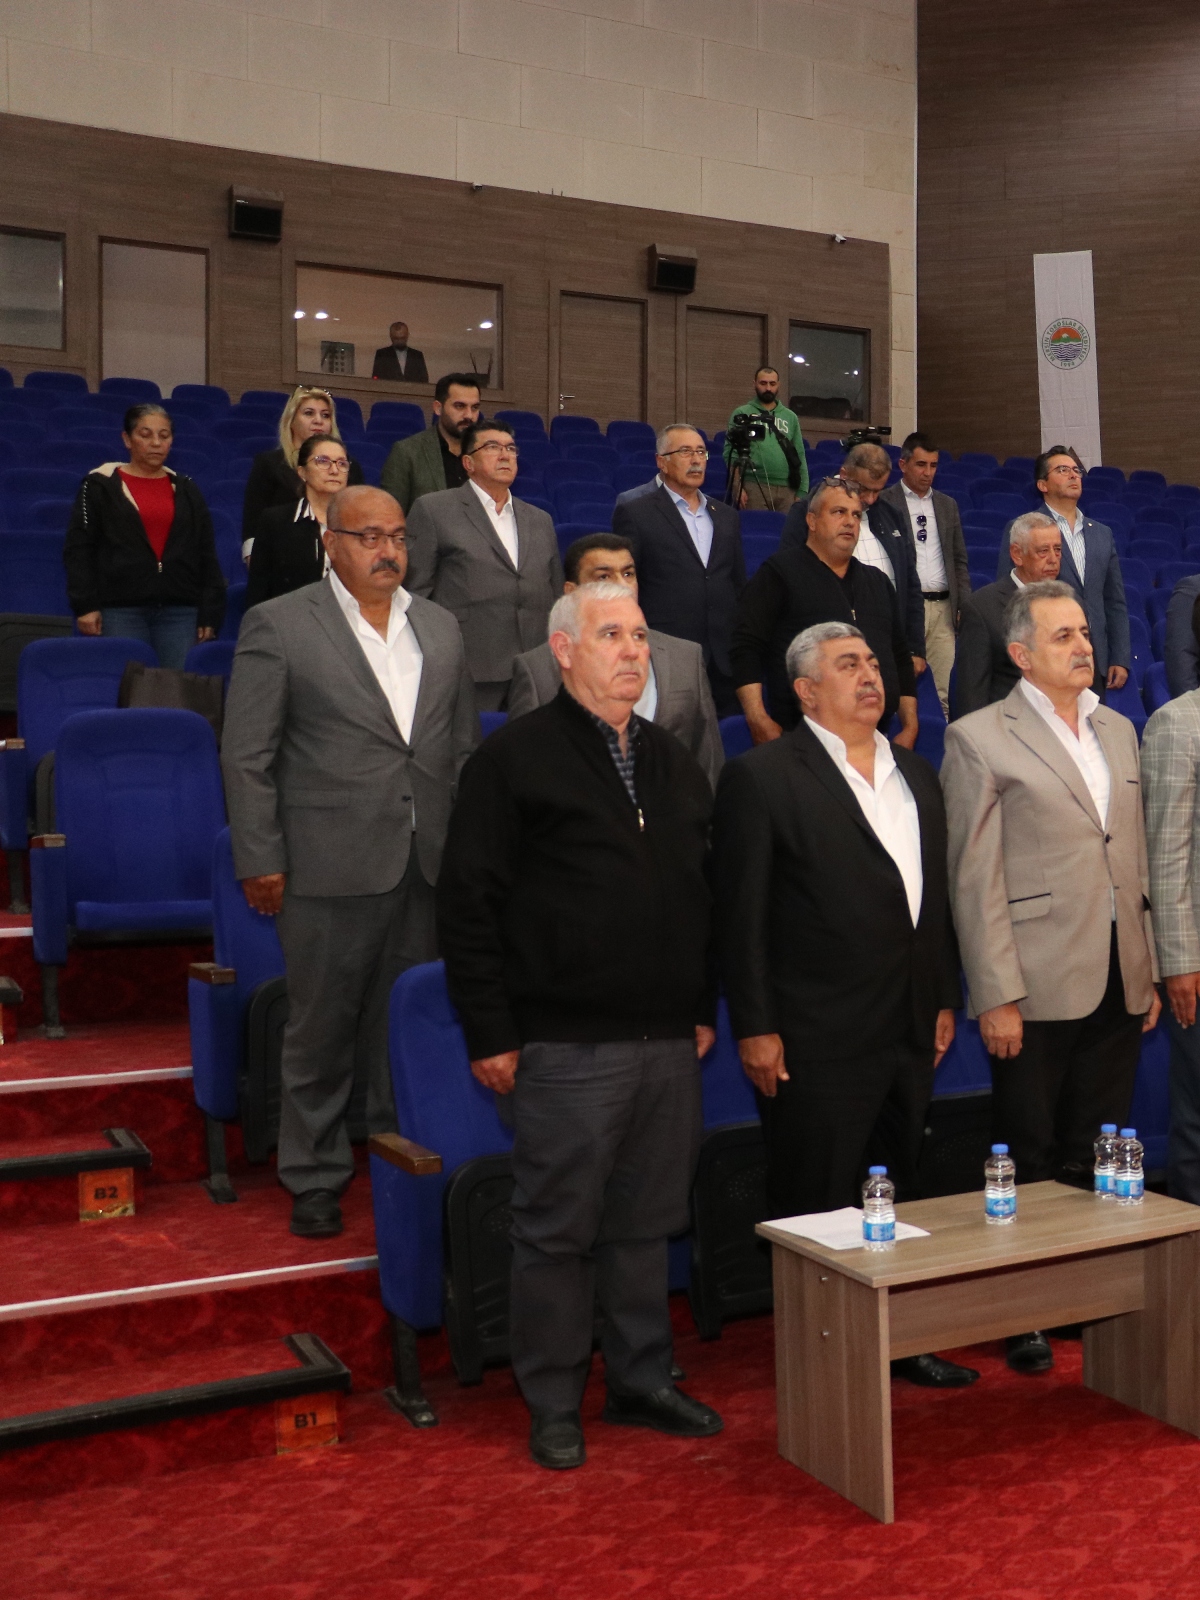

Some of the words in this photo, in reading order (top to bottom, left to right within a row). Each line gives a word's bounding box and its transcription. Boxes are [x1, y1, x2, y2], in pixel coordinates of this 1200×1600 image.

[1047, 320, 1077, 335] TOROSLAR
[94, 1186, 118, 1199] B2
[294, 1411, 317, 1429] B1
